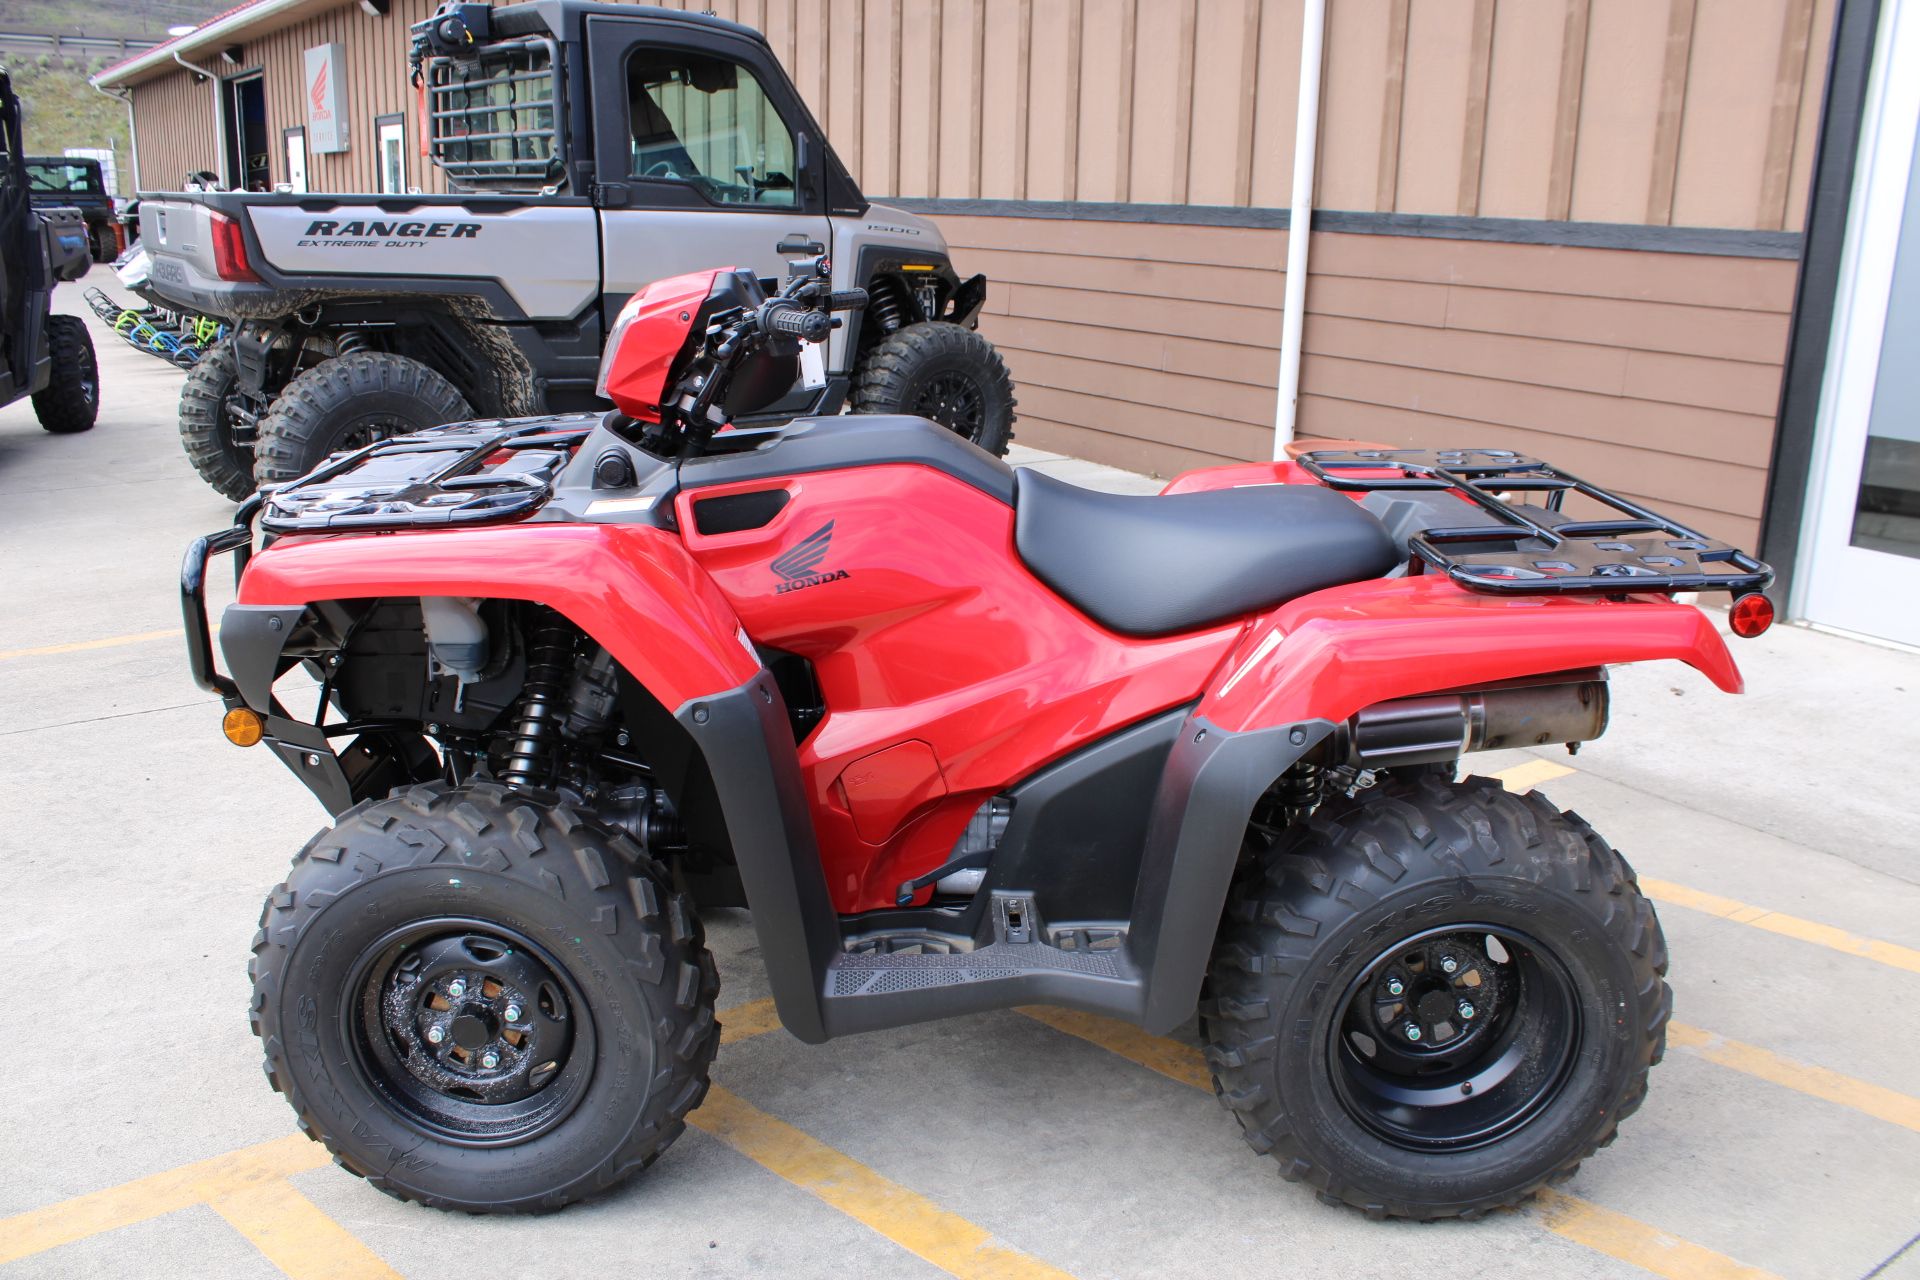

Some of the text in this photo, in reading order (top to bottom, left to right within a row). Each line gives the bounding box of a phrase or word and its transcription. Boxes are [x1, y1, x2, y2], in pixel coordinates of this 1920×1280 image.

[305, 220, 482, 238] RANGER
[867, 224, 920, 236] 1500
[297, 239, 429, 249] EXTREME DUTY
[775, 569, 851, 595] HONDA
